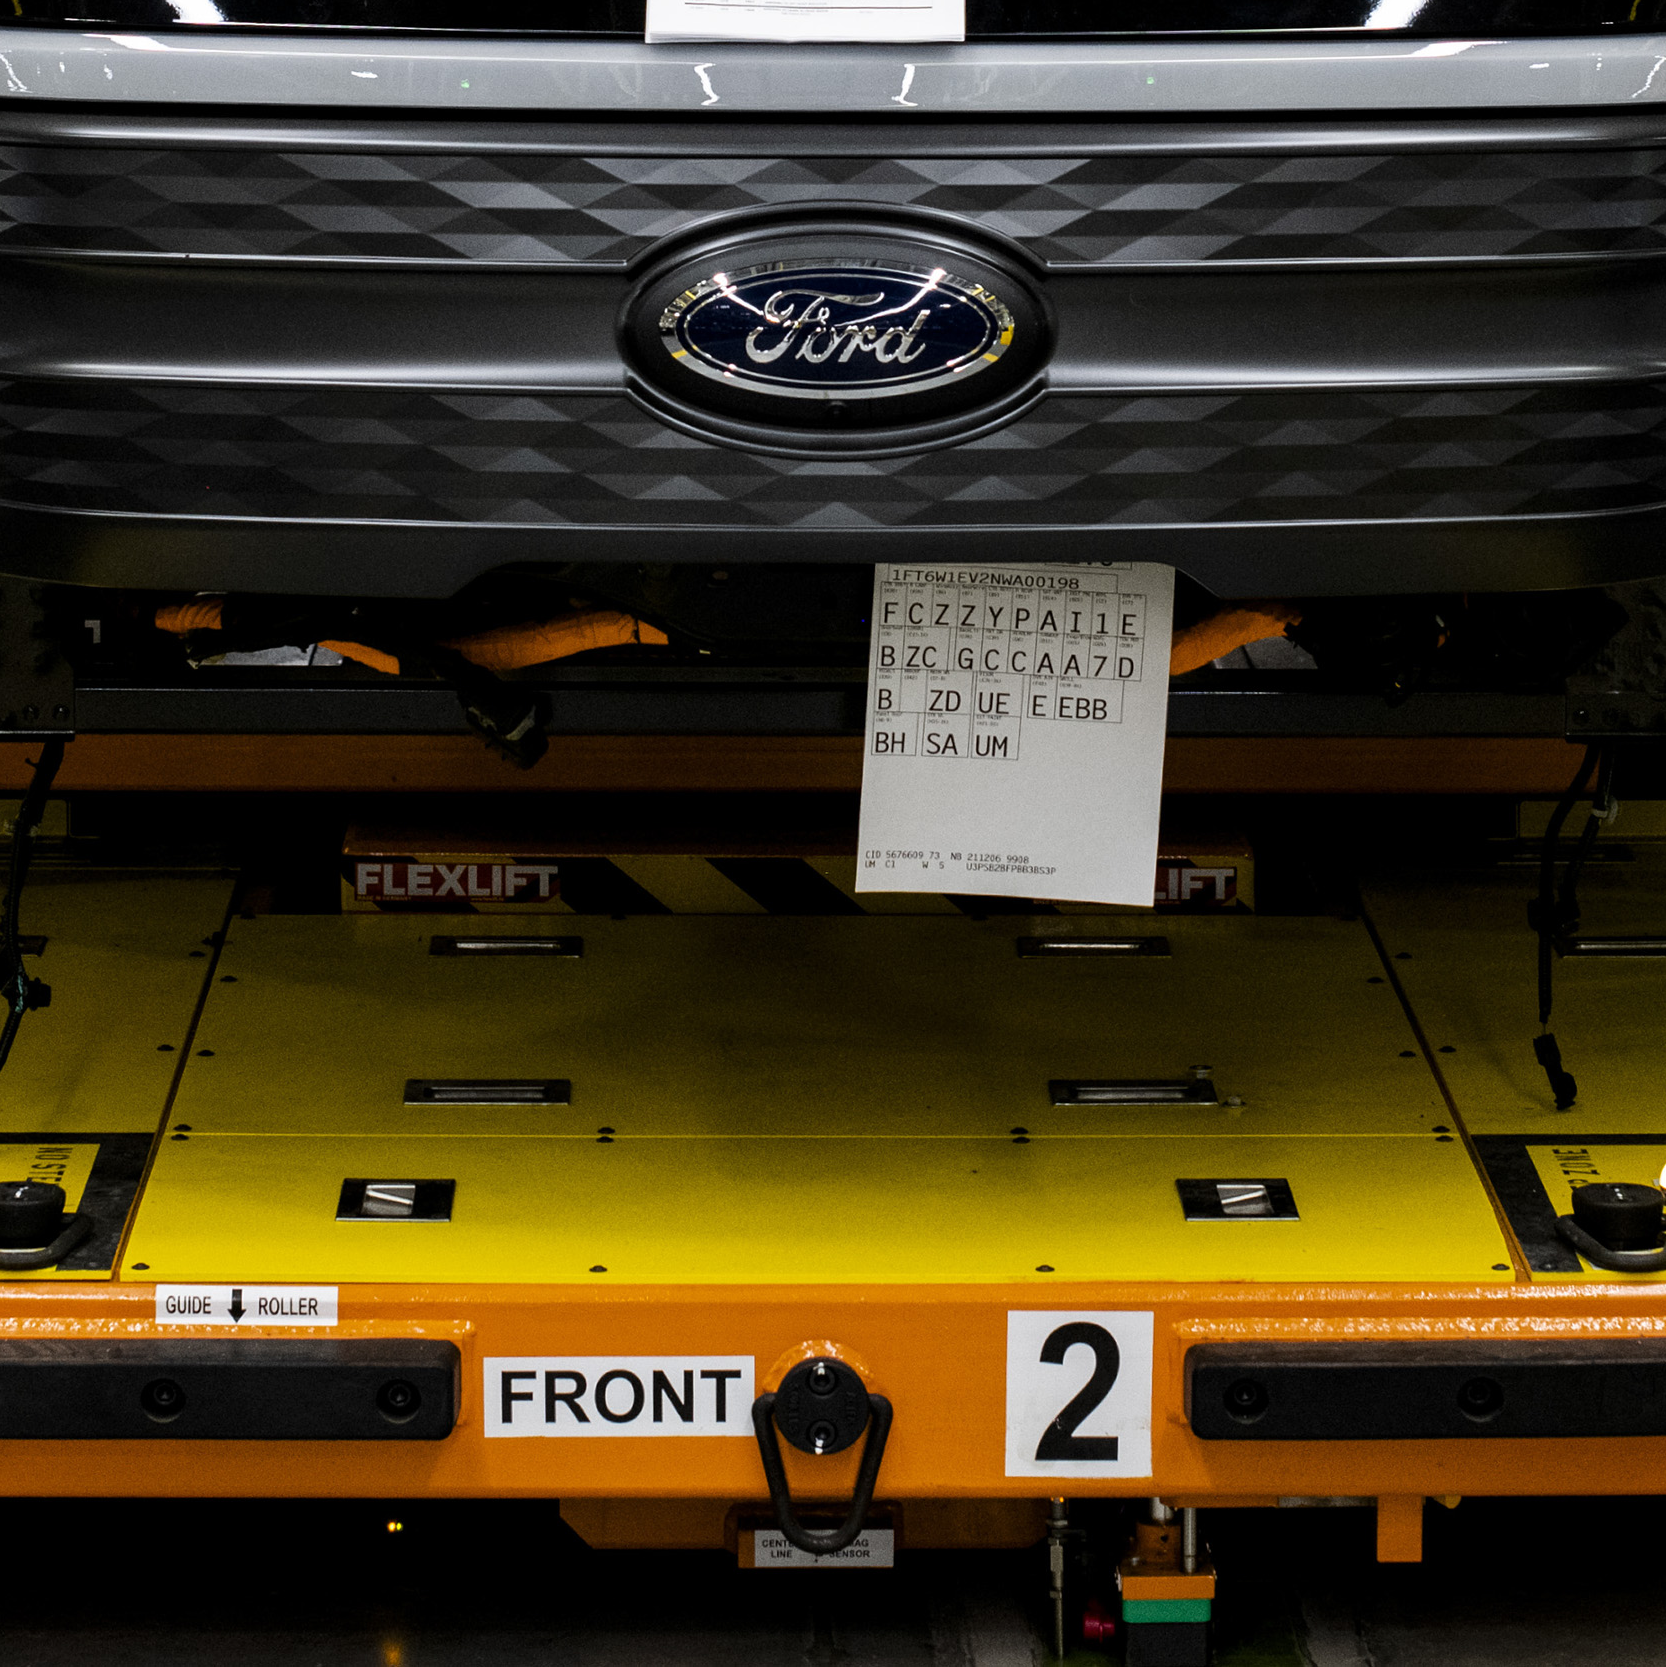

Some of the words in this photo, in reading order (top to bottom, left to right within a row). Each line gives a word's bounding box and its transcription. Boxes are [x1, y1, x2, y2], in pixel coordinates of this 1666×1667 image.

[745, 289, 930, 364] Ford
[892, 570, 1080, 590] 1FT6W1EV2NWA00198
[884, 602, 898, 623] F
[909, 603, 923, 624] C
[935, 604, 949, 625] Z
[961, 605, 975, 626] Z
[989, 607, 1003, 627] Y
[1015, 608, 1030, 628] P
[1041, 610, 1057, 631] A
[1071, 612, 1081, 632] I
[1097, 613, 1107, 634] 1
[1122, 614, 1136, 635] E
[881, 646, 895, 666] B
[907, 646, 936, 667] ZC
[958, 648, 973, 669] G
[985, 649, 999, 670] C
[1012, 651, 1026, 672] C
[1038, 653, 1053, 673] A
[1064, 655, 1080, 675] A
[1095, 656, 1107, 676] 7
[1119, 657, 1133, 678] D
[878, 689, 892, 709] B
[930, 690, 960, 711] ZD
[979, 692, 1009, 714] UE
[1033, 695, 1046, 716] E
[1060, 697, 1107, 720] EBB
[876, 732, 905, 752] BH
[928, 733, 957, 754] SA
[976, 735, 1007, 757] UM
[922, 861, 929, 869] W
[357, 863, 558, 897] FLEXLIFT
[35, 1148, 73, 1160] NO
[1552, 1149, 1600, 1175] ZONE
[166, 1295, 212, 1315] GUIDE
[258, 1296, 318, 1317] ROLLER
[501, 1370, 741, 1424] FRONT
[1035, 1322, 1120, 1462] 2
[771, 1551, 792, 1559] LINE
[829, 1551, 870, 1559] SENSOR
